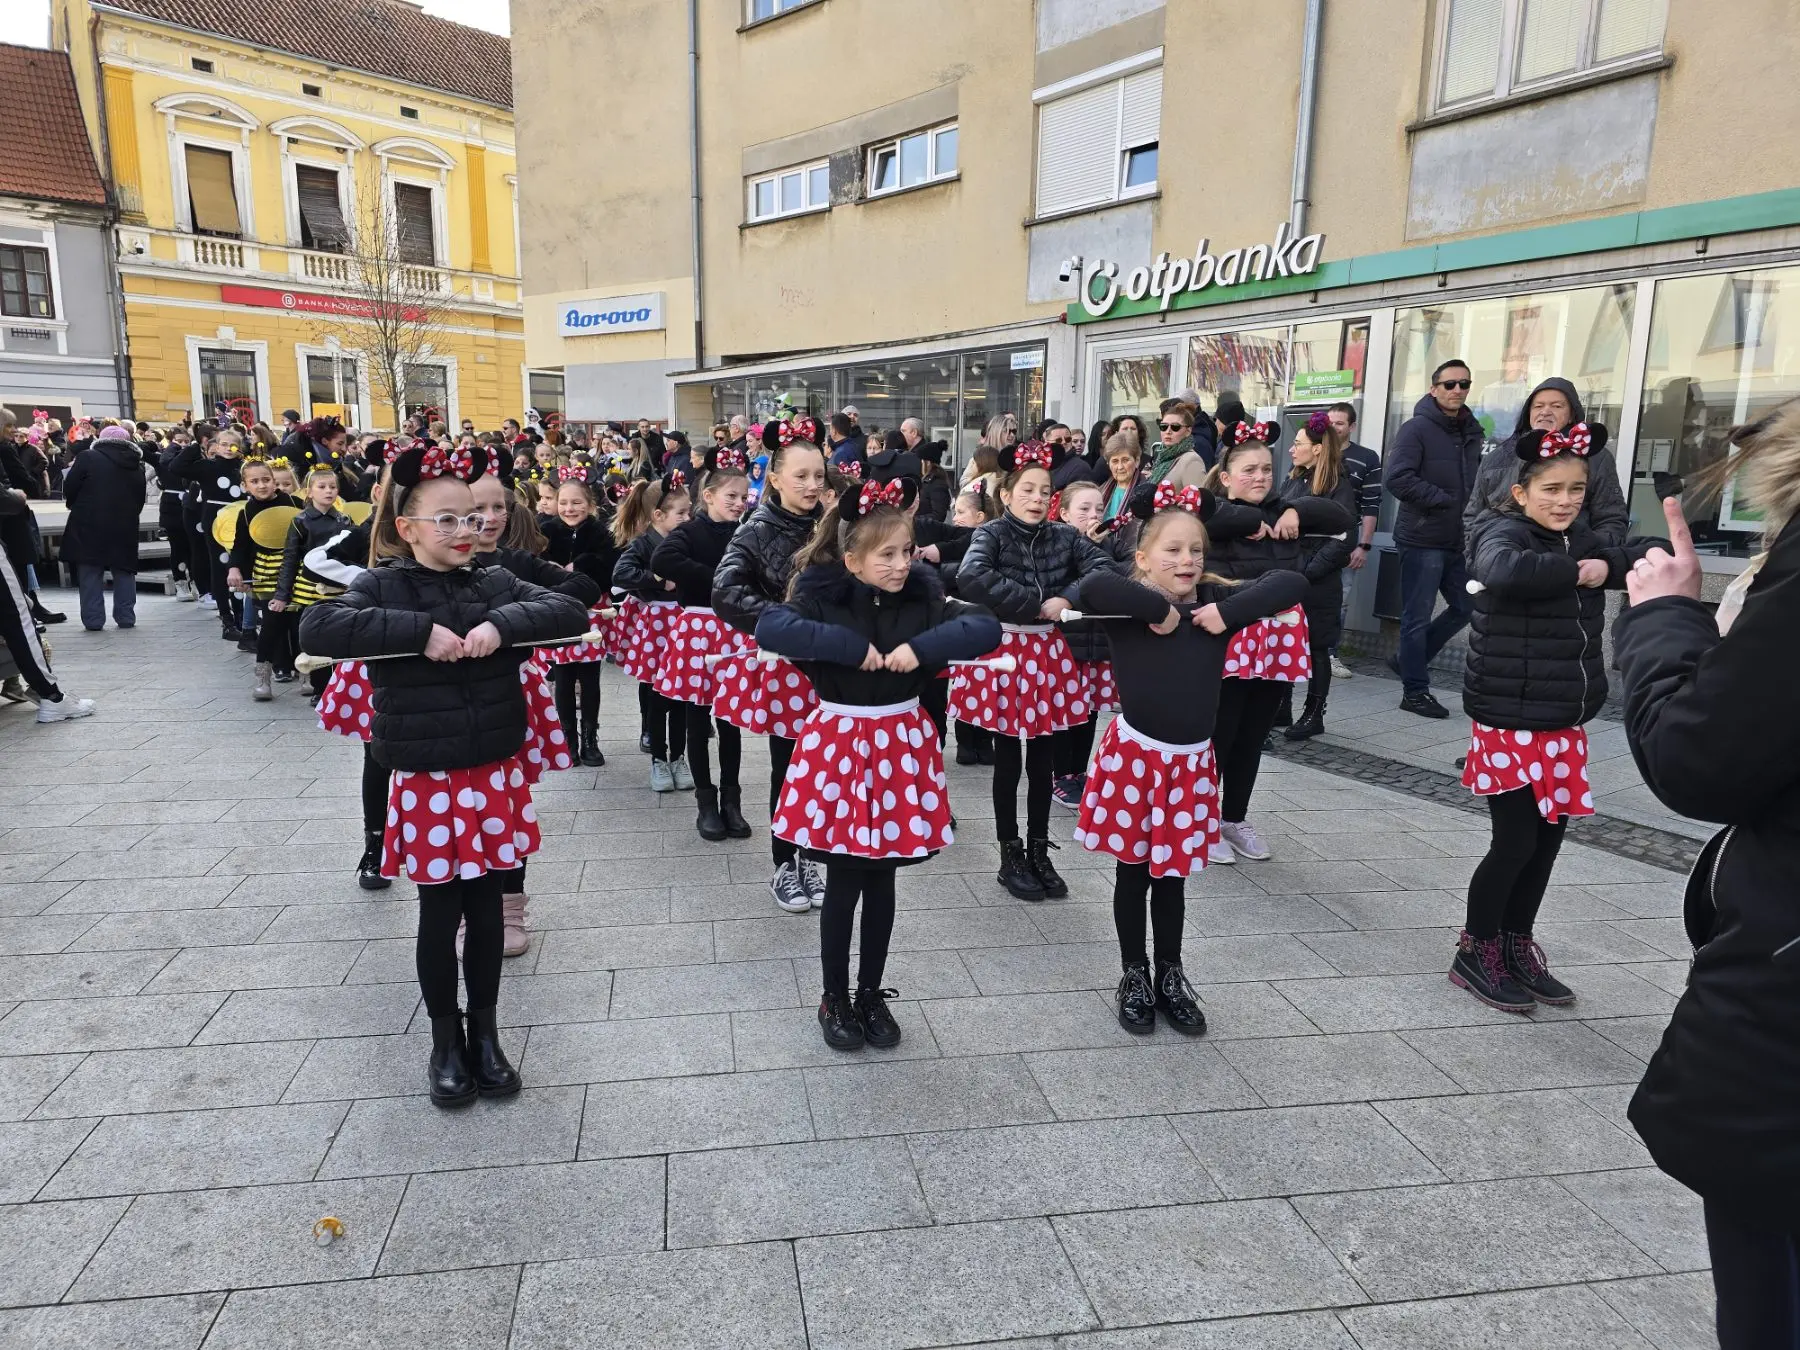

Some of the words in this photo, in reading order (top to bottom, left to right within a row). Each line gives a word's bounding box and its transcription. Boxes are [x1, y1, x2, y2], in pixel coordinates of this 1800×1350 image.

[1126, 222, 1326, 311] otpbanka
[298, 299, 329, 308] BANKA
[565, 308, 652, 328] Borovo
